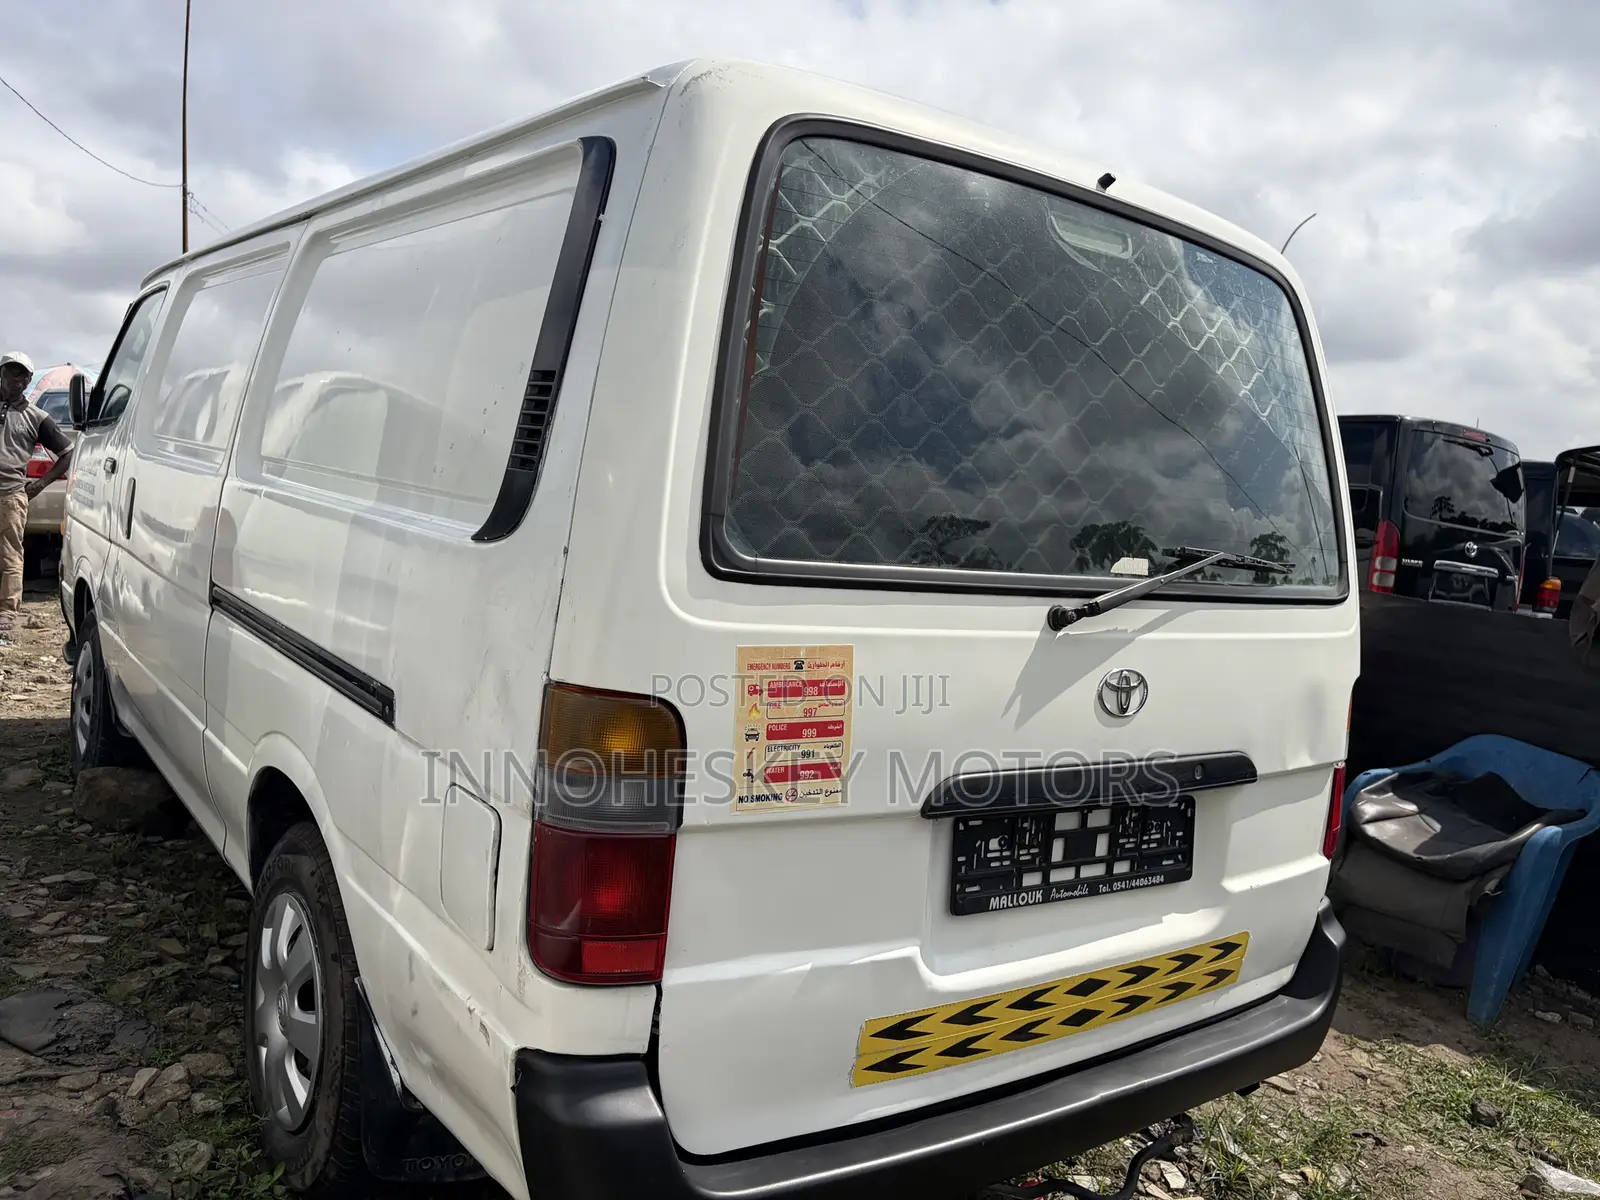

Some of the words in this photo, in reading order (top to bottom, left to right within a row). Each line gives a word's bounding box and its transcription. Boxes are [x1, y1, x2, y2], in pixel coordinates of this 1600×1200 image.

[747, 662, 770, 671] EMERGENCY
[771, 662, 792, 670] NUMBERS
[769, 680, 803, 688] AMBULANCE
[803, 686, 818, 696] 998
[768, 701, 782, 710] FIRE
[802, 707, 818, 718] 997
[768, 723, 788, 732] POLICE
[802, 728, 817, 738] 999
[767, 744, 801, 753] ELECTRICITY
[800, 749, 815, 759] 991
[766, 766, 785, 775] WATER
[799, 769, 815, 780] 992
[738, 794, 749, 804] NO
[750, 792, 783, 803] SMOKING
[988, 889, 1044, 911] MALLOUK
[1050, 883, 1090, 901] Automobile
[1099, 883, 1111, 894] Tel.
[1112, 874, 1165, 892] 0541/44063484
[402, 1153, 474, 1174] TOYO
